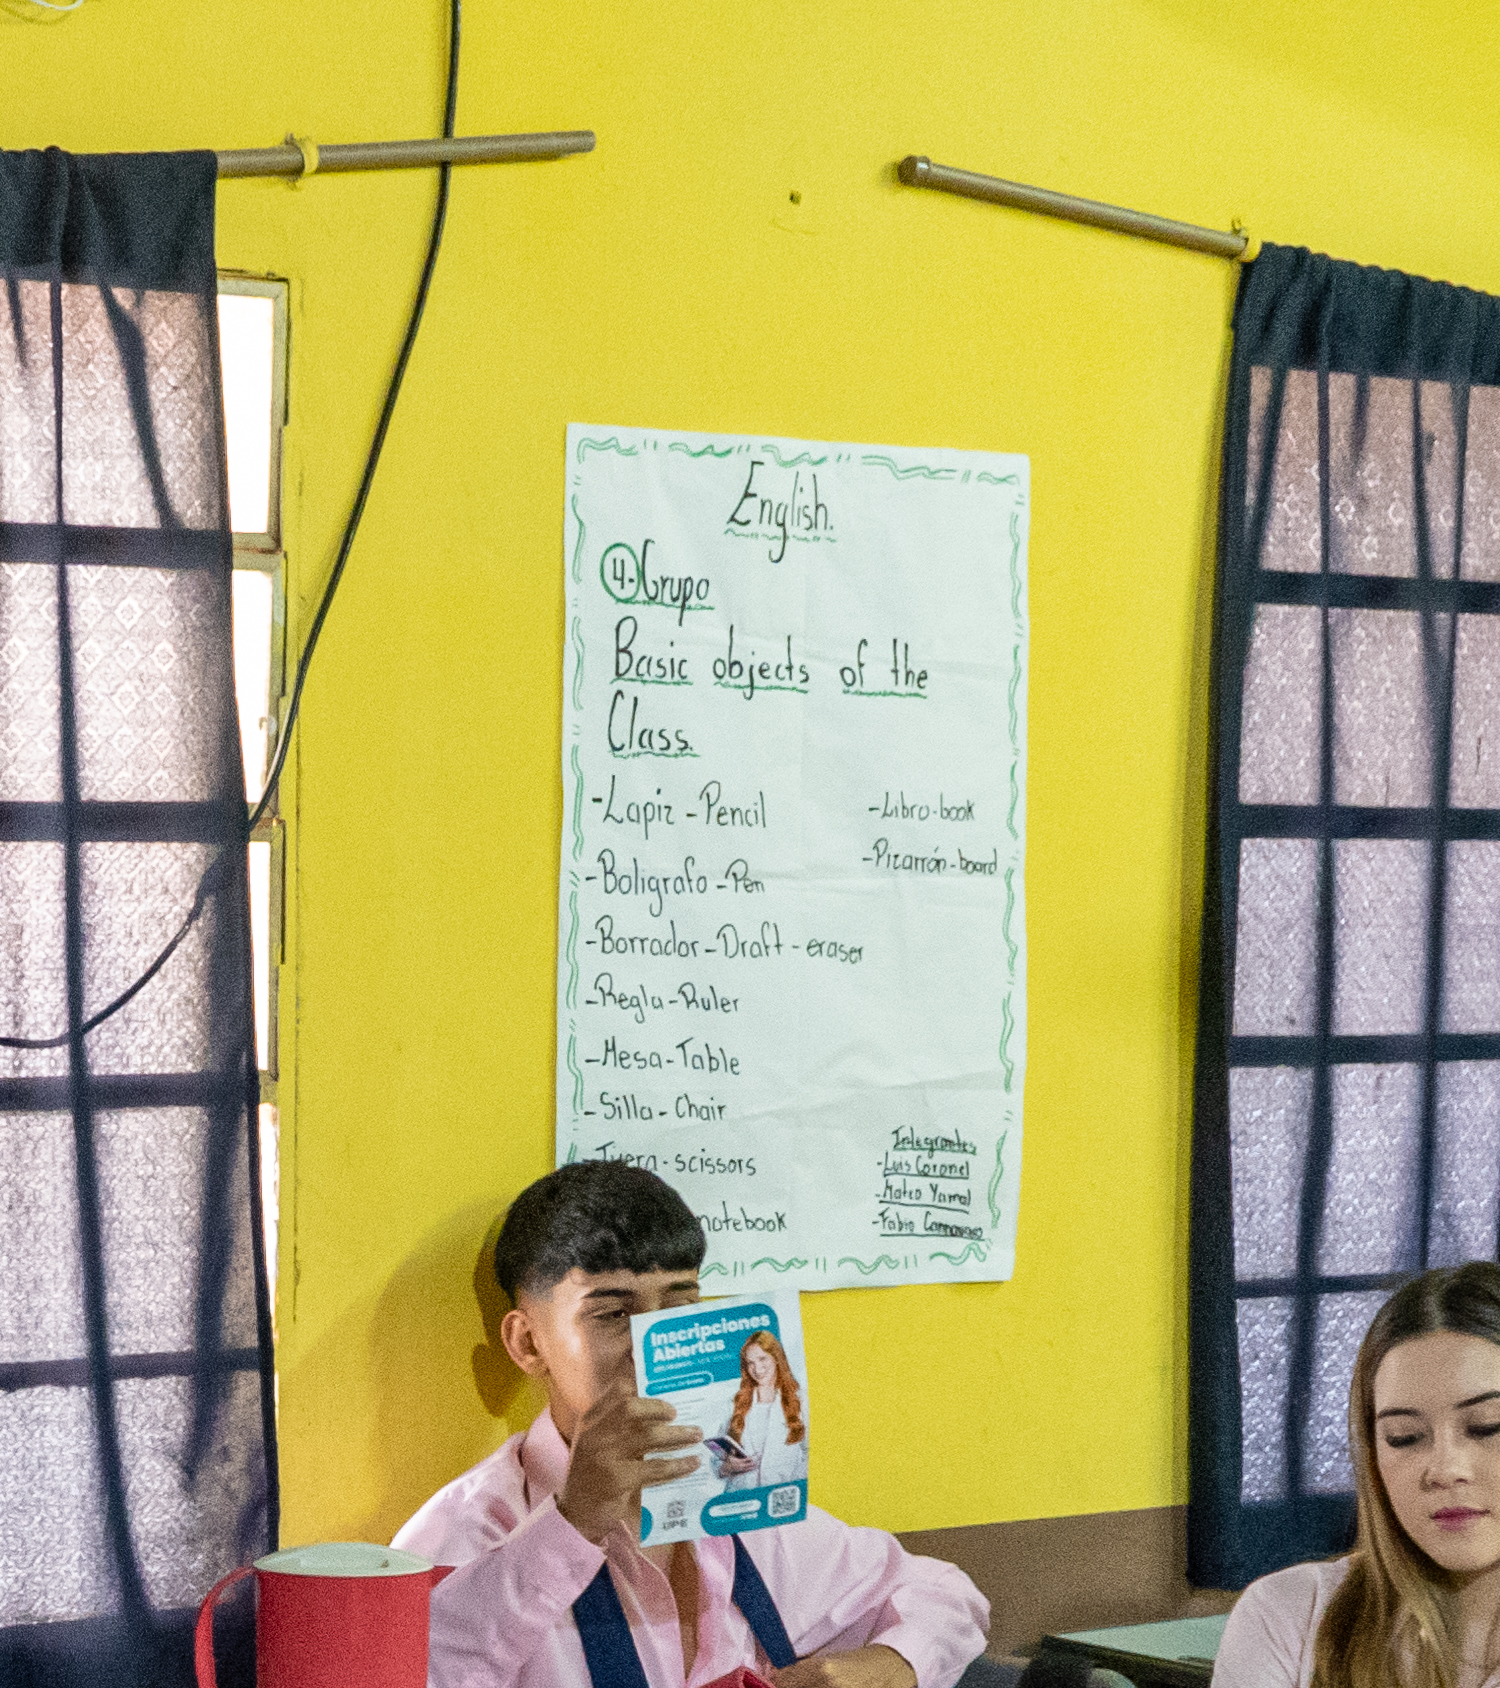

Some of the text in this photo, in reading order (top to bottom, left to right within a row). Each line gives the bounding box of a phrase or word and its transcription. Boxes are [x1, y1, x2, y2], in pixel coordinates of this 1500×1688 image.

[642, 538, 711, 627] Grupo
[615, 615, 928, 701] Basic objects of the
[650, 1313, 771, 1348] Inscripciones
[653, 1338, 726, 1364] Abiertas
